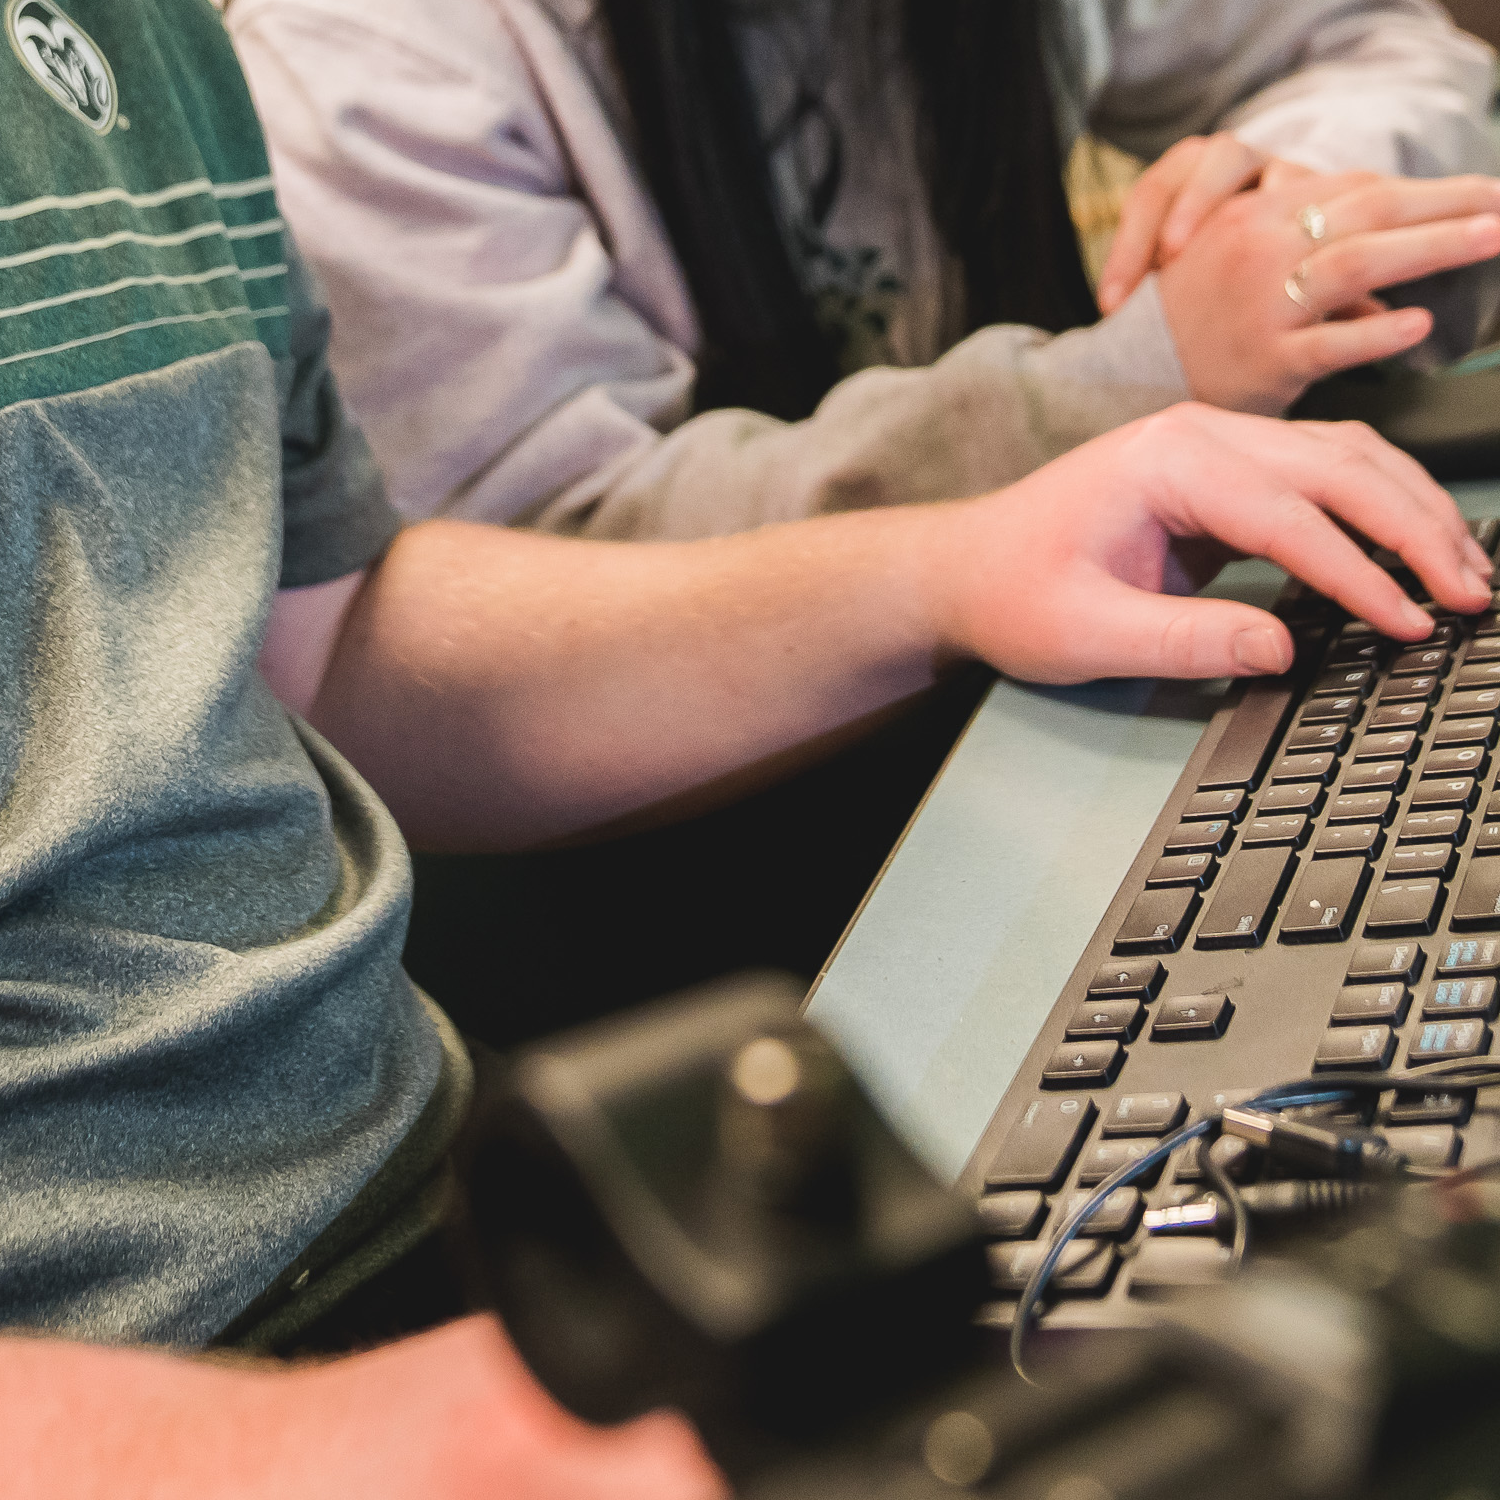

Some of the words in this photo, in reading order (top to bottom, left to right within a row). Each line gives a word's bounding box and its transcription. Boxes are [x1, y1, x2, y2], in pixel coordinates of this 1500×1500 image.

[1422, 652, 1440, 662] G
[1345, 672, 1366, 682] B
[1411, 678, 1431, 688] H
[1477, 692, 1496, 701] U
[1332, 699, 1353, 709] N
[1400, 707, 1419, 716] J
[1319, 726, 1340, 738] M
[1387, 735, 1408, 745] K
[1457, 749, 1476, 760] O
[1376, 765, 1397, 774] L
[1447, 781, 1466, 790] P
[1445, 941, 1463, 968] Screen
[1460, 941, 1478, 962] Print
[1479, 940, 1497, 963] Insert
[1378, 986, 1396, 1005] End
[1448, 981, 1465, 1005] Scroll
[1468, 980, 1485, 1006] Home
[1060, 1100, 1079, 1114] 0
